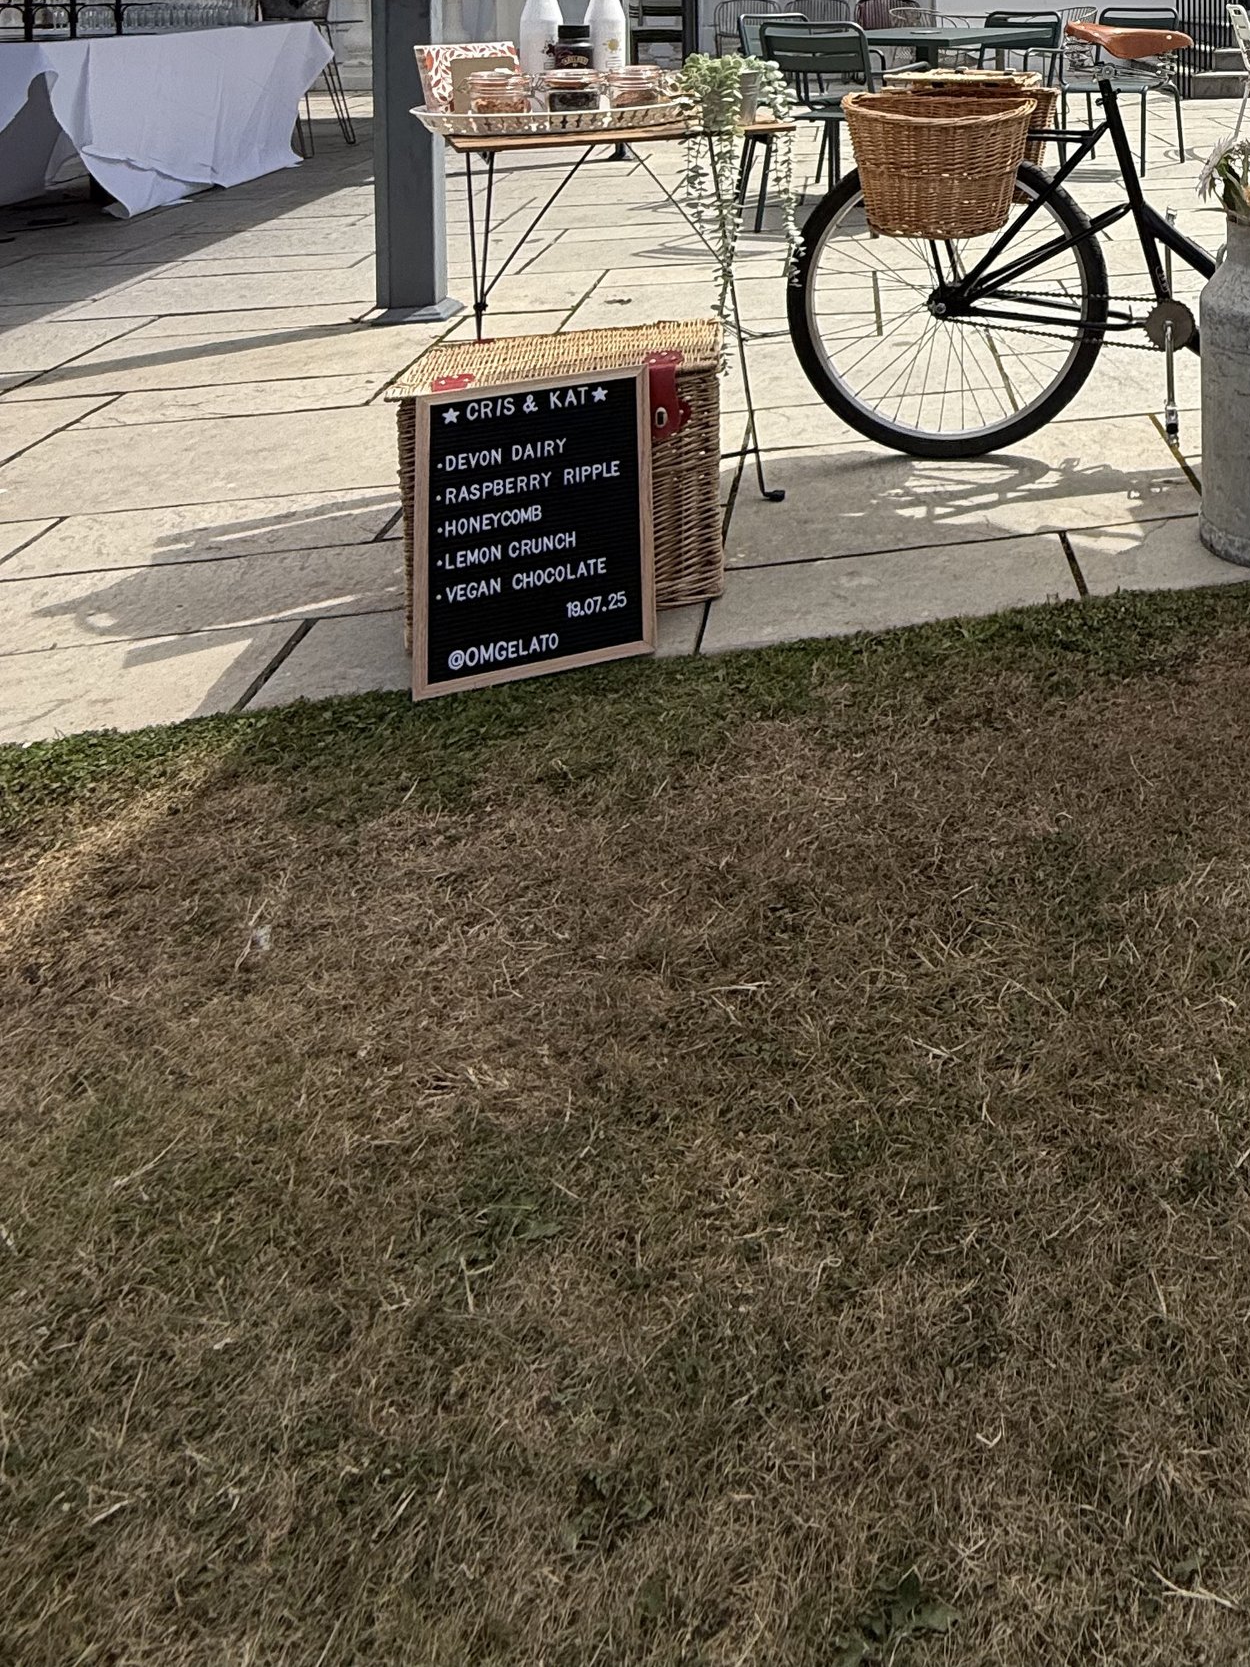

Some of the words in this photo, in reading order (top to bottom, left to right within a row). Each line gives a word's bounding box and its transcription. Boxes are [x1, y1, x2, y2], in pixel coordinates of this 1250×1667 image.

[466, 398, 516, 421] CRIS
[522, 394, 539, 414] &
[549, 386, 589, 409] KAT
[445, 447, 502, 472] DEVON
[511, 437, 567, 462] DAIRY
[445, 471, 552, 505] RASPBERRY
[563, 460, 621, 485] RIPPLE
[444, 504, 542, 538] HONEYCOMB
[445, 544, 502, 570] LEMON
[508, 530, 576, 558] CRUNCH
[445, 577, 501, 603] VEGAN
[512, 557, 607, 590] CHOCOLATE
[566, 590, 627, 618] 19.07.25
[448, 632, 559, 671] @OMGELATO
